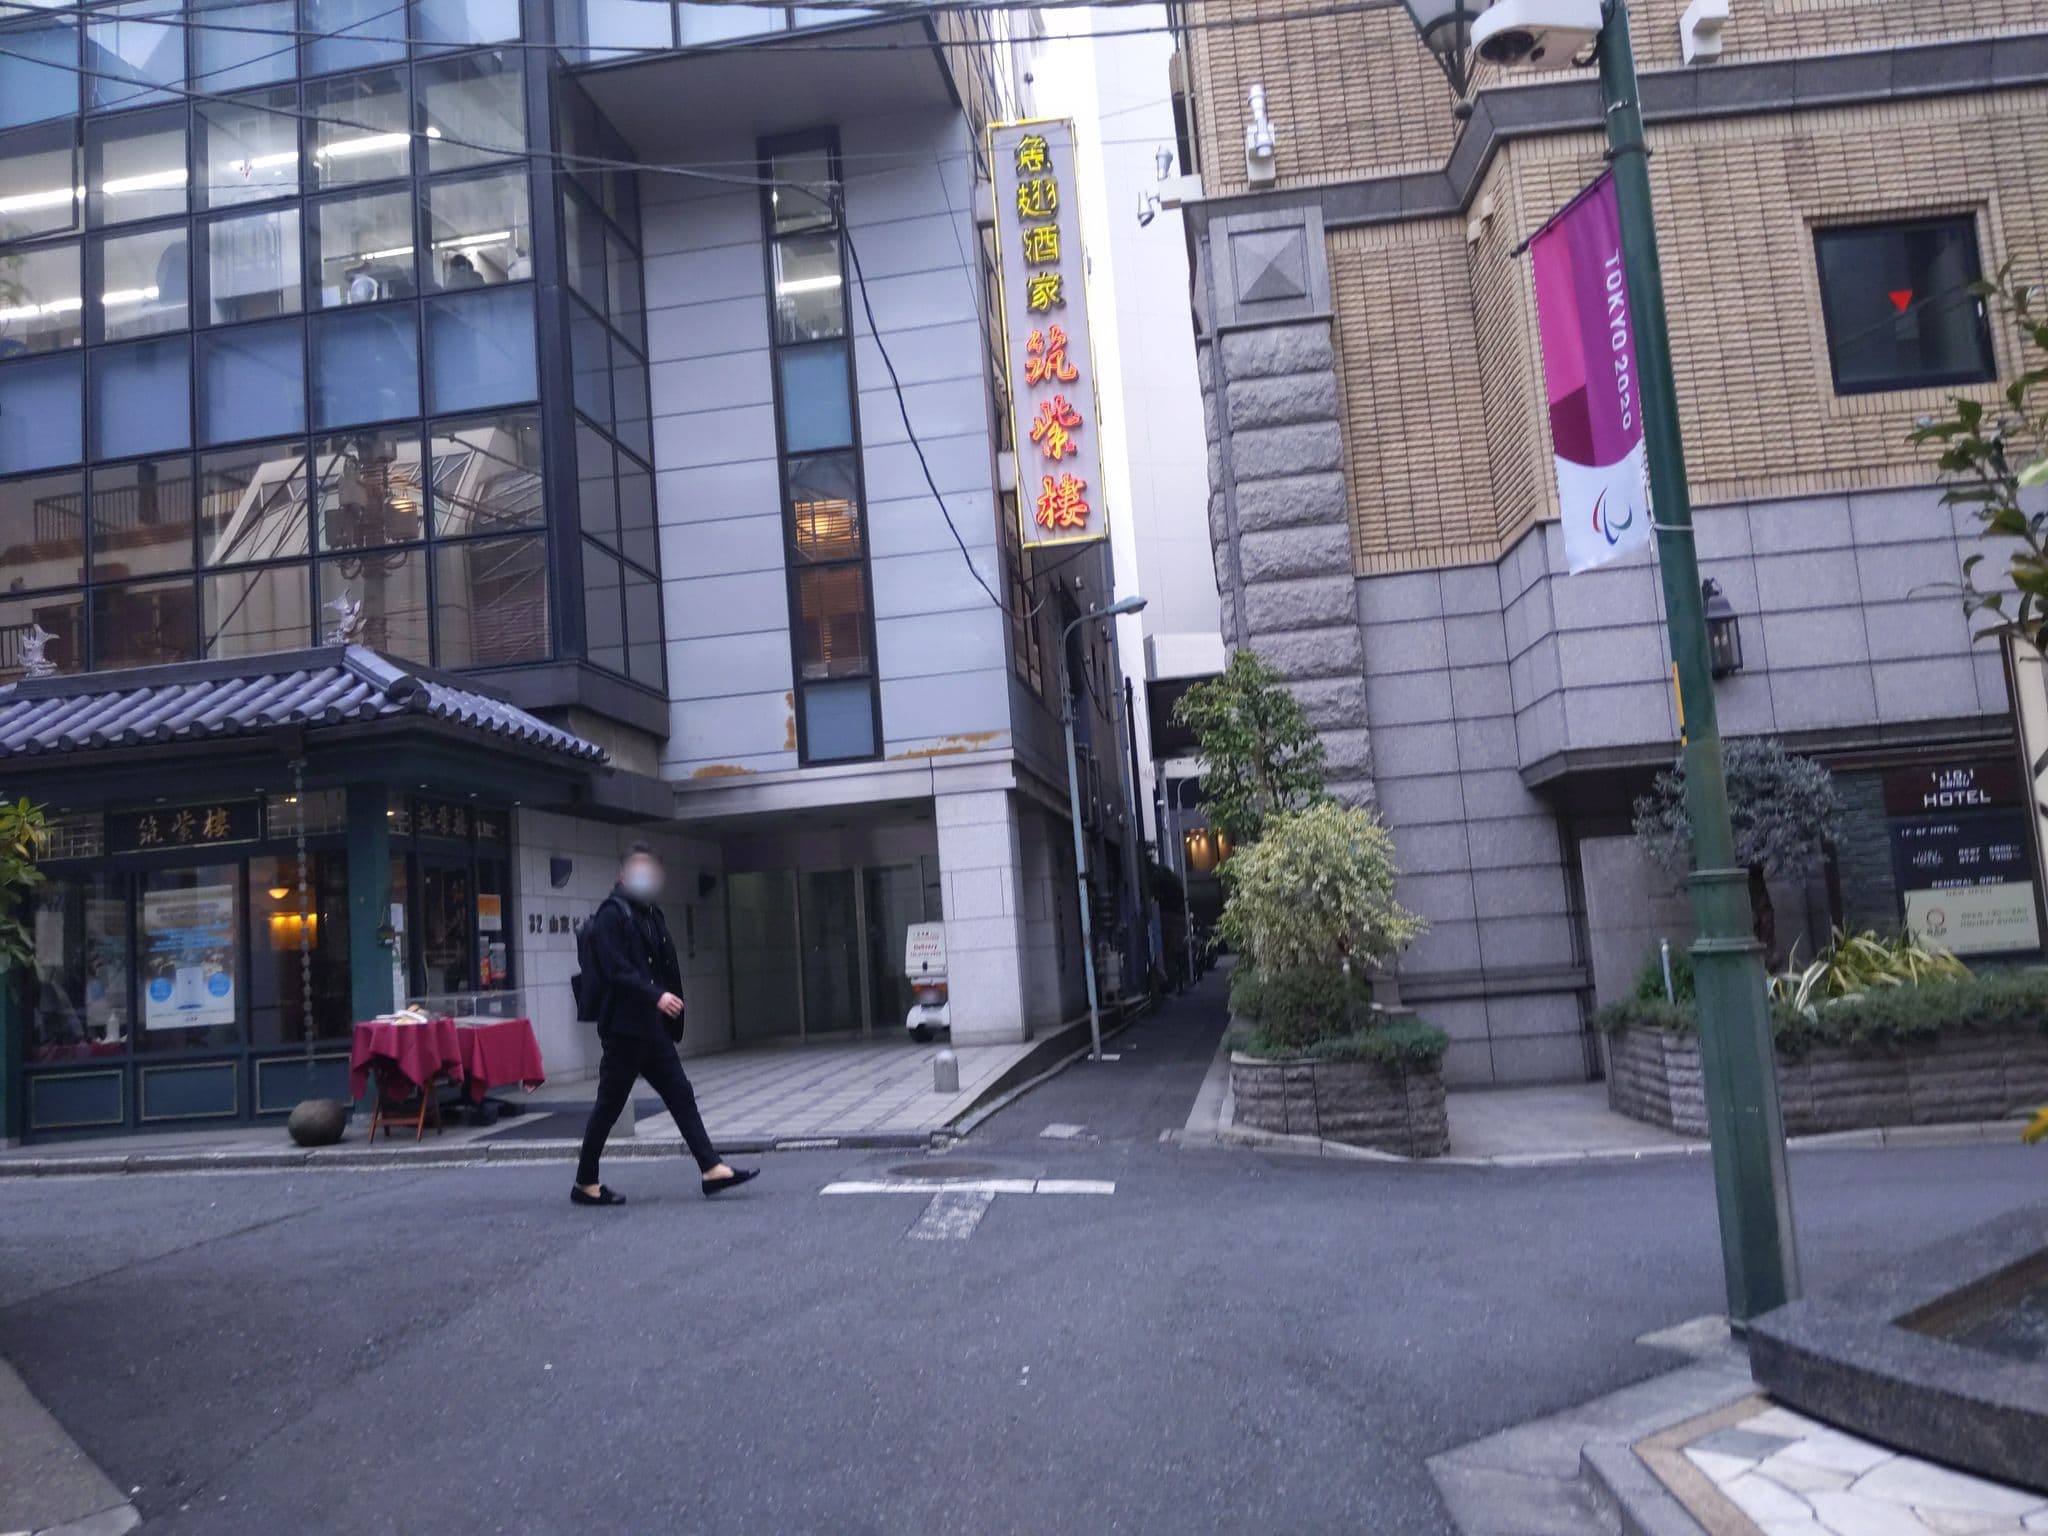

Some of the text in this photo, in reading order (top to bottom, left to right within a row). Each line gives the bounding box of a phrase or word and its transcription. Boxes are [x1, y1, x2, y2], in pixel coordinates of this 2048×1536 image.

[1024, 324, 1090, 530] 筑紫樓
[1604, 248, 1633, 431] TOKYO 2020
[1923, 789, 1992, 809] HOTEL
